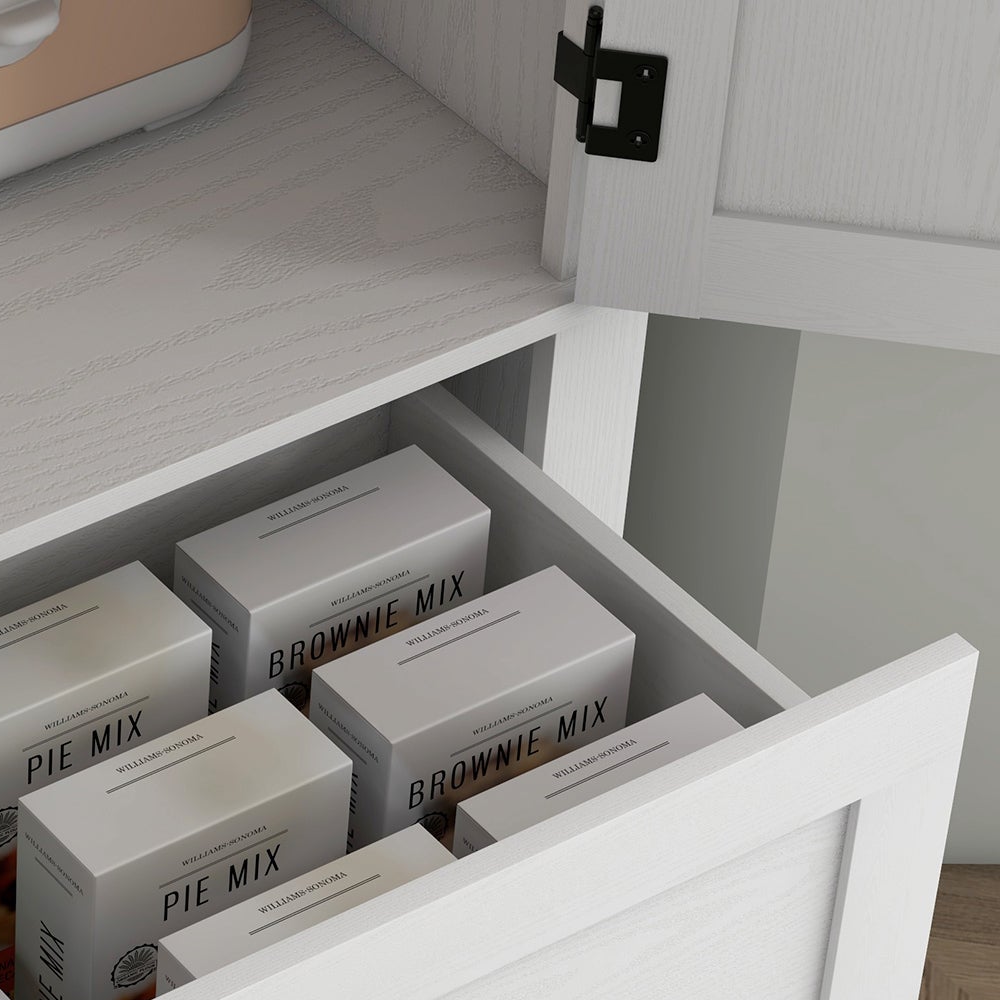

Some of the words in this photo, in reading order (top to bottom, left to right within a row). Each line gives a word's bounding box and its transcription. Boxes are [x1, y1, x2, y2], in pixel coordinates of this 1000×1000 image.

[268, 599, 400, 680] BROWNIE
[415, 570, 465, 616] MIX
[27, 741, 73, 785] PIE
[90, 710, 143, 757] MIX
[408, 726, 541, 810] BROWNIE
[557, 696, 608, 744] MIX
[163, 876, 209, 922] PIE
[228, 844, 281, 893] MIX
[39, 920, 64, 981] MIX
